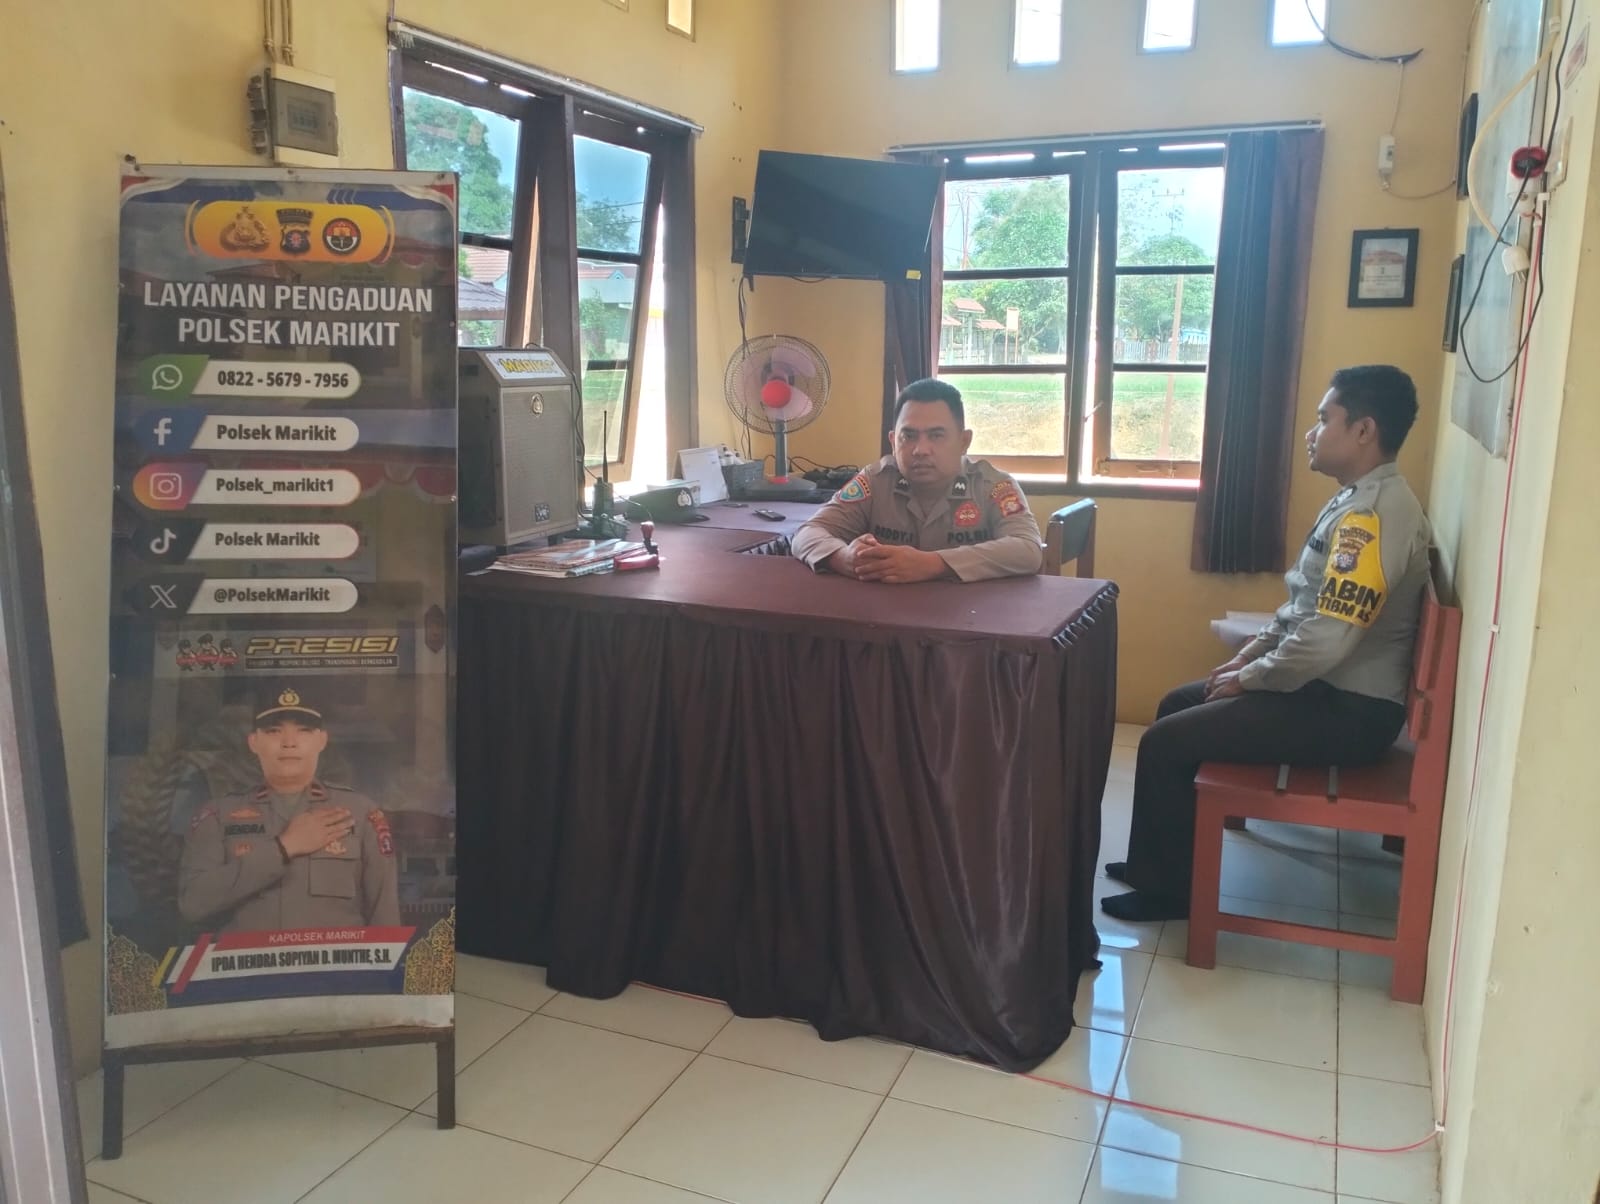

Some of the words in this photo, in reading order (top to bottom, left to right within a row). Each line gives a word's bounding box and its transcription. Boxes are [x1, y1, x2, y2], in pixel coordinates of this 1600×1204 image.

[143, 281, 266, 310] LAYANAN
[275, 285, 433, 313] PENGADUAN
[178, 318, 282, 345] POLSEK
[289, 321, 400, 347] MARIKIT
[217, 370, 254, 387] 0822
[266, 371, 302, 388] 5679
[314, 373, 349, 388] 7956
[216, 424, 272, 441] Polsek
[275, 425, 337, 441] Marikit
[216, 477, 334, 495] Polsek_marikit1
[215, 532, 263, 546] Polsek
[266, 532, 320, 546] Marikit
[213, 588, 331, 602] @PolsekMarikit
[248, 636, 400, 655] PRESISI
[268, 932, 324, 944] KAPOLSEK
[325, 930, 367, 942] MARIKIT
[211, 956, 237, 973] IPDA
[237, 953, 278, 972] HENDRA
[375, 948, 392, 964] S.H.
